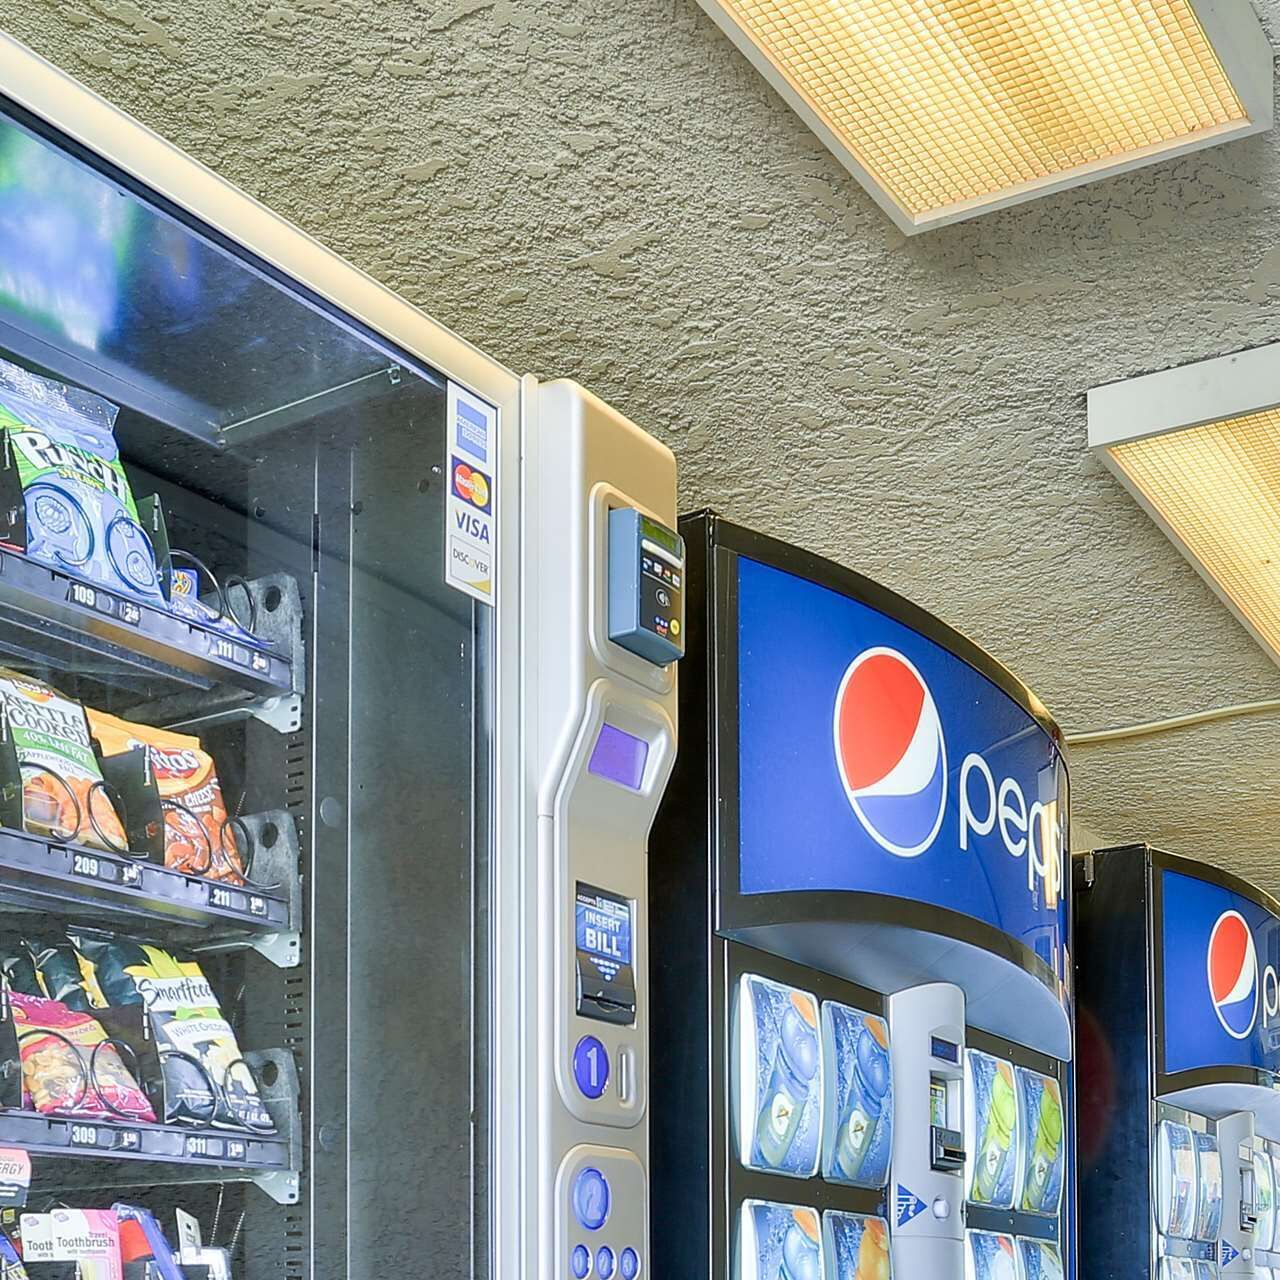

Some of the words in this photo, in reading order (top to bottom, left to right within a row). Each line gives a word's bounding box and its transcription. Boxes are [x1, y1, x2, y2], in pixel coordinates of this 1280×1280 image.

[455, 509, 490, 544] VISA
[453, 548, 489, 575] DISCOVER
[73, 584, 95, 607] 109
[216, 640, 233, 659] 111
[959, 752, 1066, 901] pepsi
[74, 857, 98, 875] 209
[213, 888, 229, 907] 211
[585, 910, 621, 933] INSERT
[585, 927, 622, 957] BILL
[586, 1047, 598, 1087] 1
[73, 1125, 96, 1144] 309
[189, 1138, 206, 1155] 311
[56, 1236, 116, 1248] Toothbrush
